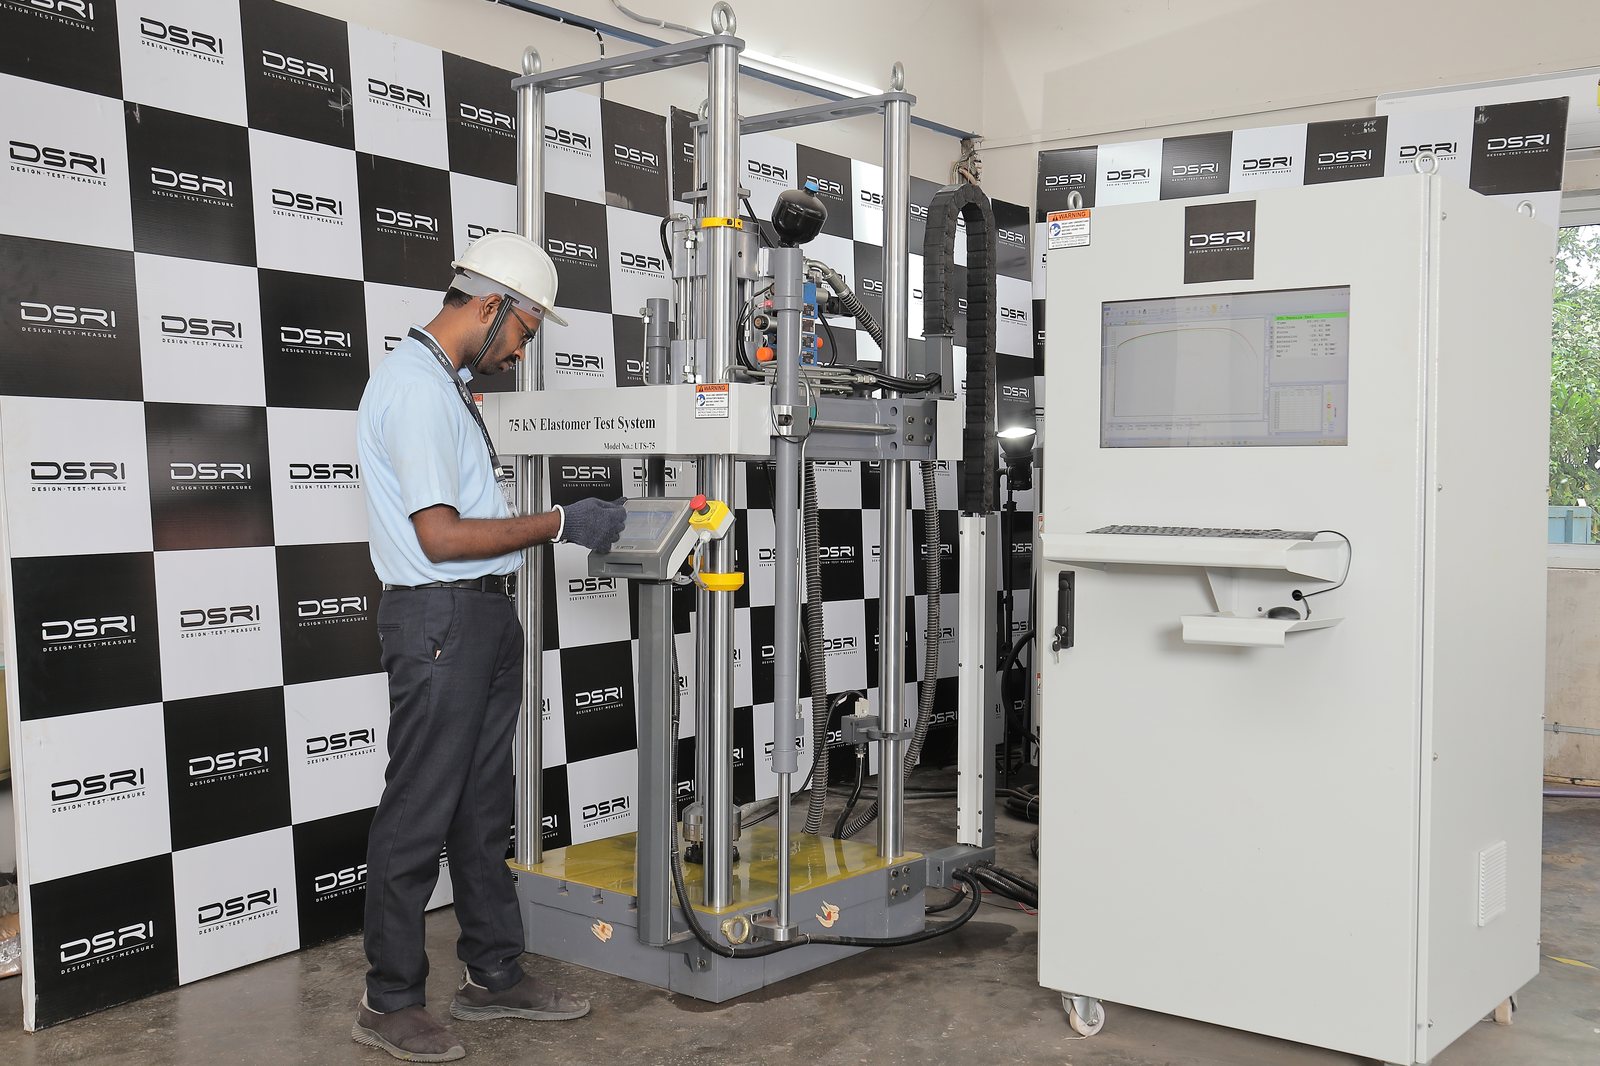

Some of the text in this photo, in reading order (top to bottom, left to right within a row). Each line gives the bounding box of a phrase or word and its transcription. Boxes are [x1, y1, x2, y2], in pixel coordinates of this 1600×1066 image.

[140, 17, 223, 55] DSRI
[263, 50, 334, 83] DSRI
[368, 78, 430, 108] DSRI
[460, 103, 515, 130] DSRI
[1399, 141, 1458, 157] DSRI
[1487, 133, 1550, 150] DSRI
[9, 140, 105, 175] DSRI
[615, 144, 658, 167] DSRI
[1242, 156, 1293, 170] DSRI
[1318, 149, 1372, 164] DSRI
[748, 160, 788, 181] DSRI
[1045, 173, 1086, 185] DSRI
[1106, 168, 1150, 181] DSRI
[1172, 162, 1219, 176] DSRI
[151, 167, 233, 197] DSRI
[272, 188, 342, 216] DSRI
[376, 207, 438, 232] DSRI
[1059, 211, 1087, 220] WARNING
[999, 229, 1025, 244] DSRI
[1189, 230, 1251, 246] DSRI
[549, 239, 597, 260] DSRI
[621, 252, 664, 271] DSRI
[21, 302, 116, 328] DSRI
[1001, 307, 1027, 321] DSRI
[161, 315, 242, 339] DSRI
[281, 326, 351, 348] DSRI
[555, 352, 603, 369] DSRI
[1003, 386, 1029, 398] DSRI
[508, 415, 656, 433] 75 kN Elastomer Test System
[603, 442, 621, 450] Model
[634, 442, 656, 450] UTS-75
[31, 462, 125, 480] DSRI
[170, 463, 251, 479] DSRI
[289, 463, 359, 479] DSRI
[562, 466, 610, 479] DSRI
[569, 576, 616, 592] DSRI
[180, 604, 260, 628] DSRI
[298, 595, 367, 617] DSRI
[42, 614, 135, 640] DSRI
[576, 685, 623, 706] DSRI
[306, 727, 375, 755] DSRI
[189, 745, 268, 776] DSRI
[51, 766, 144, 801] DSRI
[583, 795, 629, 820] DSRI
[315, 864, 367, 893] DSR
[198, 886, 277, 924] DSRI
[60, 919, 154, 963] DSRI
